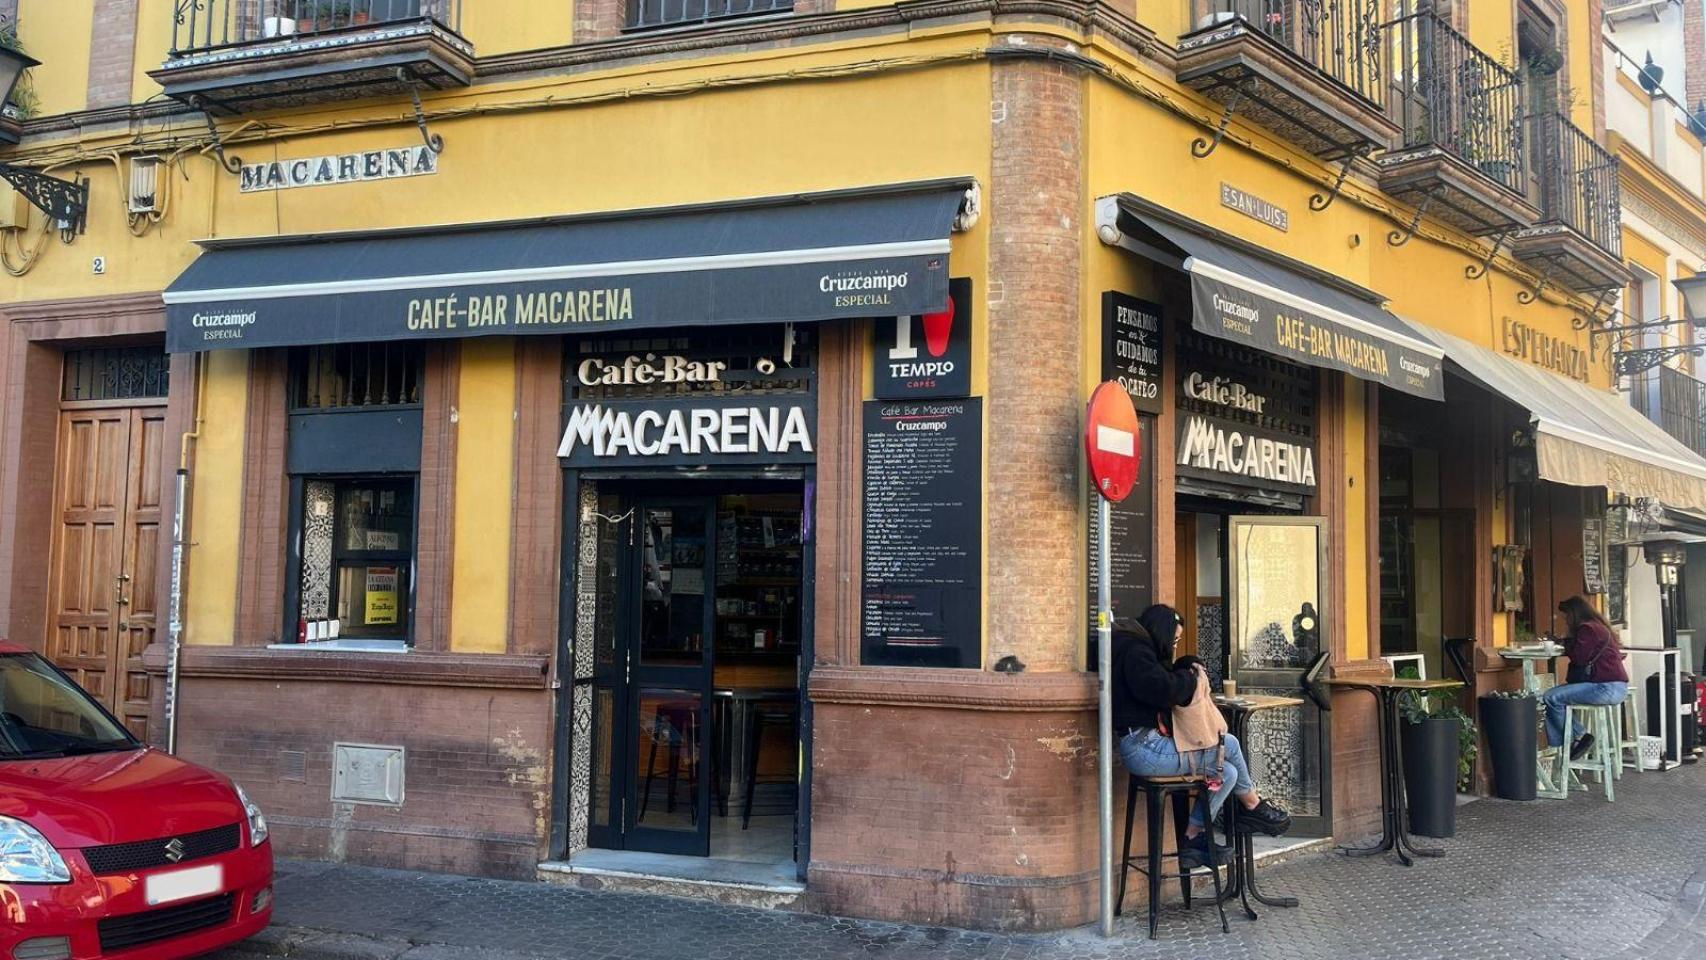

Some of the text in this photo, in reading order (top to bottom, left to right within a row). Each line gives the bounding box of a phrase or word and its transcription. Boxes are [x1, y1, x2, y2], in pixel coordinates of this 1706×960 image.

[241, 147, 438, 190] MACARENA
[1256, 199, 1281, 225] LUIS
[94, 258, 103, 272] 2
[820, 272, 908, 292] Cruzcampo
[407, 287, 634, 330] CAFÉ-BAR MACARENA
[836, 294, 891, 307] ESPECIAL
[1213, 293, 1259, 323] Cruzcampo
[192, 311, 257, 328] Cruzcampo
[1117, 305, 1158, 333] PENSAMOS
[204, 329, 243, 340] ESPECIAL
[1276, 313, 1389, 377] CAFÉ-BAR MACARENA
[1116, 339, 1158, 365] CUIDAMOS
[1502, 316, 1590, 384] ESPERANZA
[578, 353, 727, 386] Café-Bar
[889, 361, 954, 378] TEMPLO
[1127, 361, 1148, 377] de tu
[1184, 371, 1266, 414] Café-Bar
[904, 405, 919, 415] Bar
[556, 404, 813, 458] MACARENA
[896, 421, 948, 431] Cruzcampo
[1177, 416, 1316, 486] MACARENA
